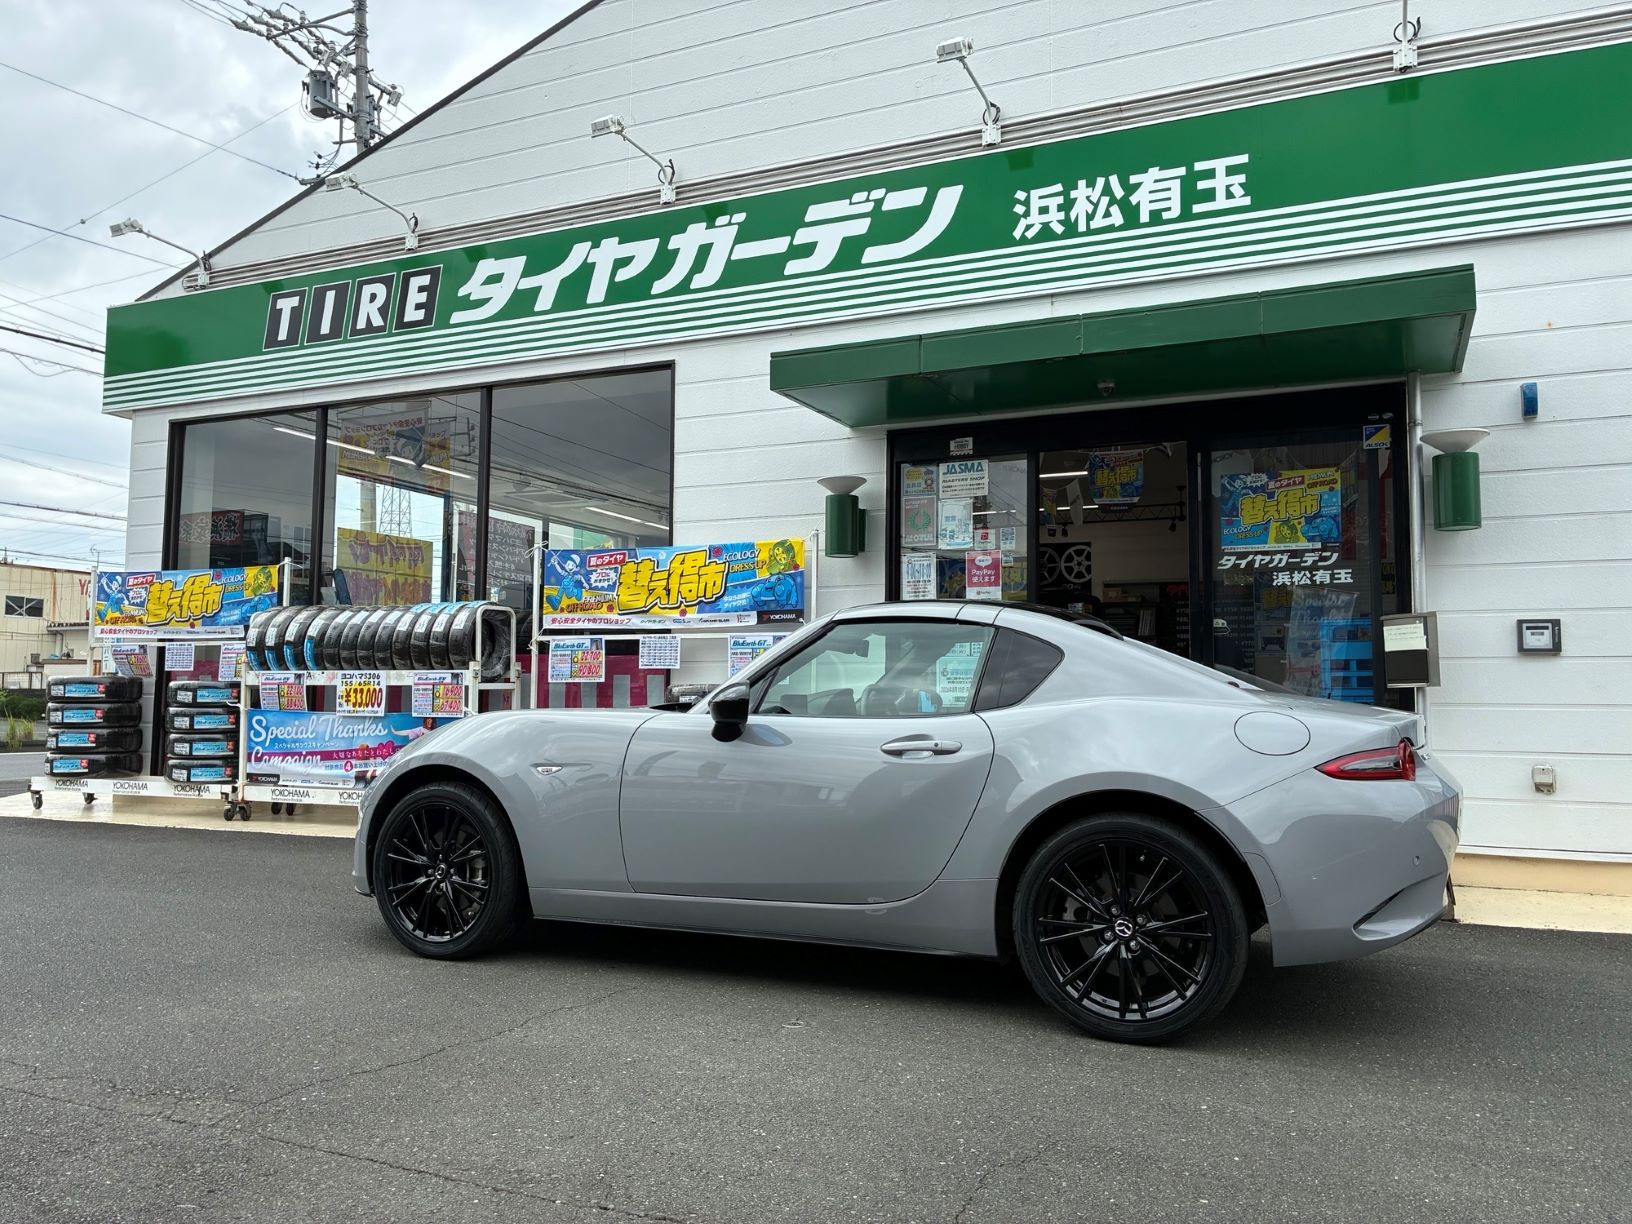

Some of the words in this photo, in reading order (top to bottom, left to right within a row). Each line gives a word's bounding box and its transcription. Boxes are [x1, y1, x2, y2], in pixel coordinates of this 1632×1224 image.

[275, 274, 432, 341] TIRE
[449, 184, 964, 324] タイヤガーデン
[1011, 153, 1252, 241] 浜松有玉
[942, 462, 984, 475] JASMA
[1240, 488, 1320, 525] 替え得市
[589, 554, 623, 566] 夏のタイヤ
[723, 548, 761, 561] ECOLOGY
[1217, 551, 1339, 570] タイヤガーデン
[618, 549, 726, 612] 替え得市
[971, 569, 996, 577] PayPay
[1272, 568, 1354, 586] 浜松有玉
[147, 573, 224, 626] 替え得市
[344, 687, 383, 709] ¥33,000
[250, 715, 317, 747] Special
[319, 715, 388, 741] Thanks
[251, 746, 322, 775] Campaign
[55, 779, 88, 788] YOKOHAMA
[113, 782, 148, 790] YOKOHAMA
[173, 785, 211, 794] YOKOHAMA
[270, 788, 310, 798] YOKOHAMA
[338, 791, 362, 800] YOKOH
